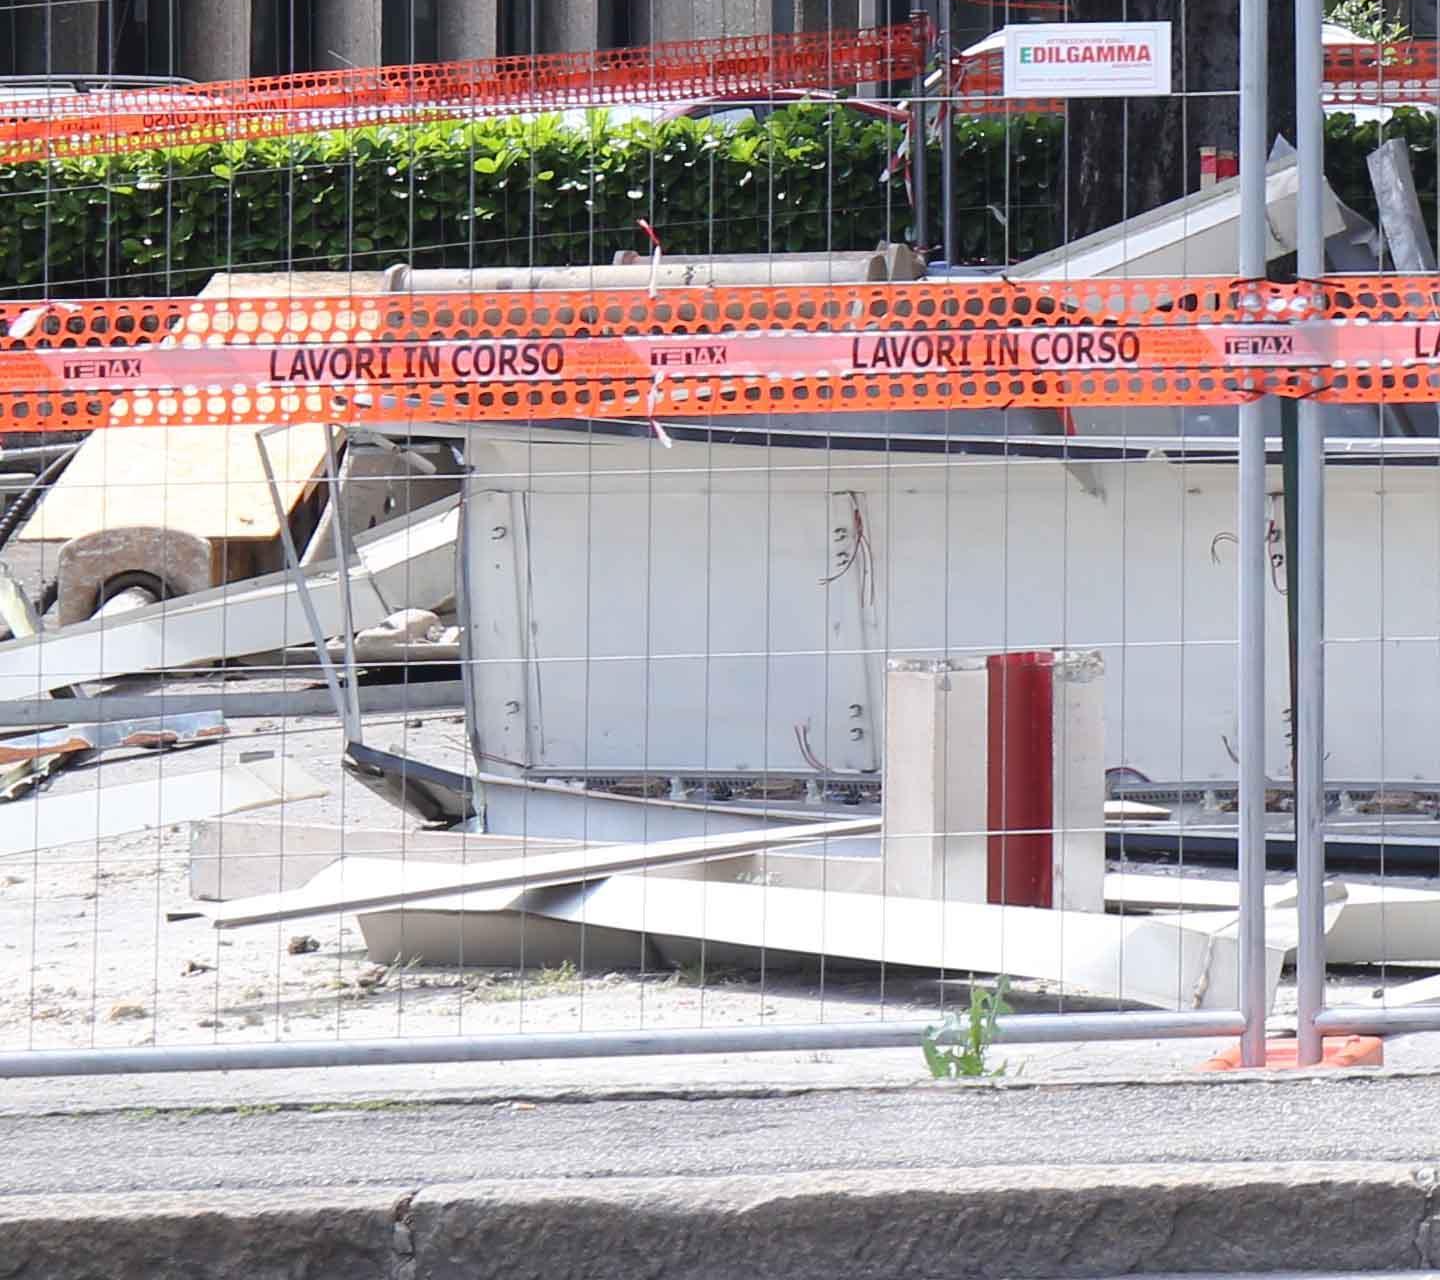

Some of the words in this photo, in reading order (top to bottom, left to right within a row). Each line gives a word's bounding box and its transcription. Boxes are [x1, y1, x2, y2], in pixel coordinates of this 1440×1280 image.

[1019, 45, 1151, 64] EDILGAMMA
[651, 345, 726, 366] TENAX
[852, 333, 972, 369] LAVORI
[983, 333, 1018, 365] IN
[1030, 330, 1140, 364] CORSO
[1225, 335, 1293, 356] TENAX
[64, 359, 141, 379] TENAX
[270, 344, 390, 382] LAVORI
[405, 346, 440, 378] IN
[452, 342, 565, 378] CORSO
